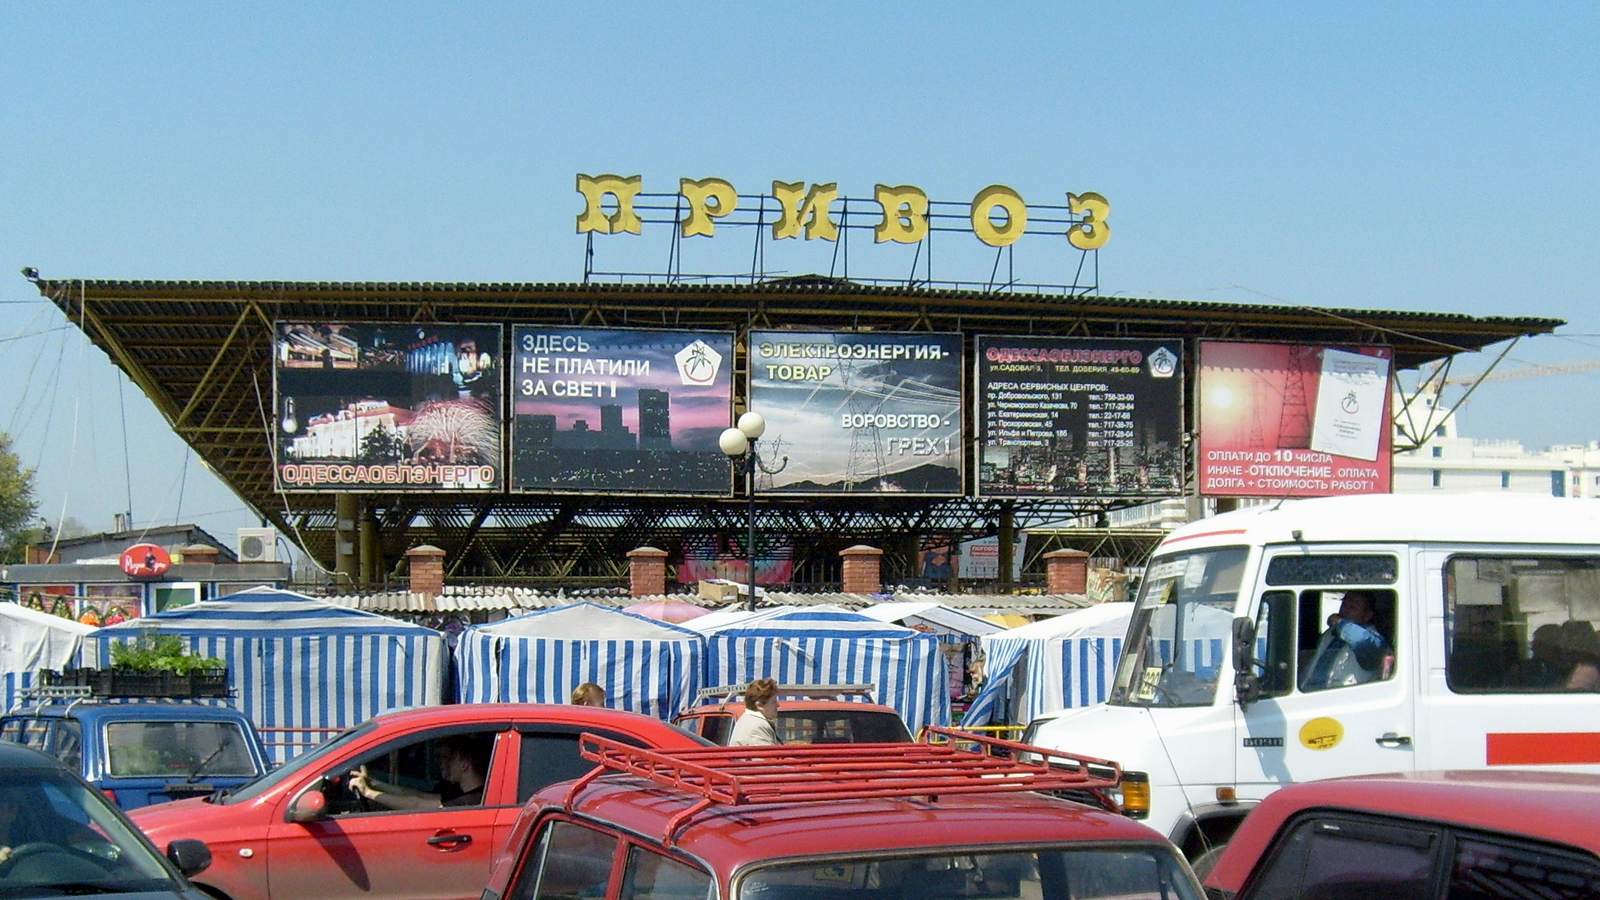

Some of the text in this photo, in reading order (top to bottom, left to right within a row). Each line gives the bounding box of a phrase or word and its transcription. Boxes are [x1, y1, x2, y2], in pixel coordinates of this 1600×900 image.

[576, 173, 1111, 250] ПРИВОЗ
[522, 334, 591, 354] ЗДЕСЬ
[986, 347, 1143, 365] ОДЕССАОБЛЭНЕРГО
[522, 357, 650, 376] НЕ ПЛАТИЛИ
[766, 364, 832, 382] ТОВАР
[522, 379, 548, 396] ЗА
[988, 382, 1109, 392] АДРЕСА СЕРВИСНЫХ ЦЕНТРОВ:
[842, 413, 941, 429] ВОРОВСТВО
[1207, 450, 1333, 464] ОПЛАТИ ДО 10 ЧИСЛА
[283, 464, 495, 486] ОДЕССАОБЛЭНЕРГО
[1207, 465, 1242, 475] ИНАЧЕ
[1338, 468, 1379, 479] ОПЛАТА
[1207, 478, 1245, 489] ДОЛГА
[1257, 479, 1328, 490] СТОИМОСТЬ
